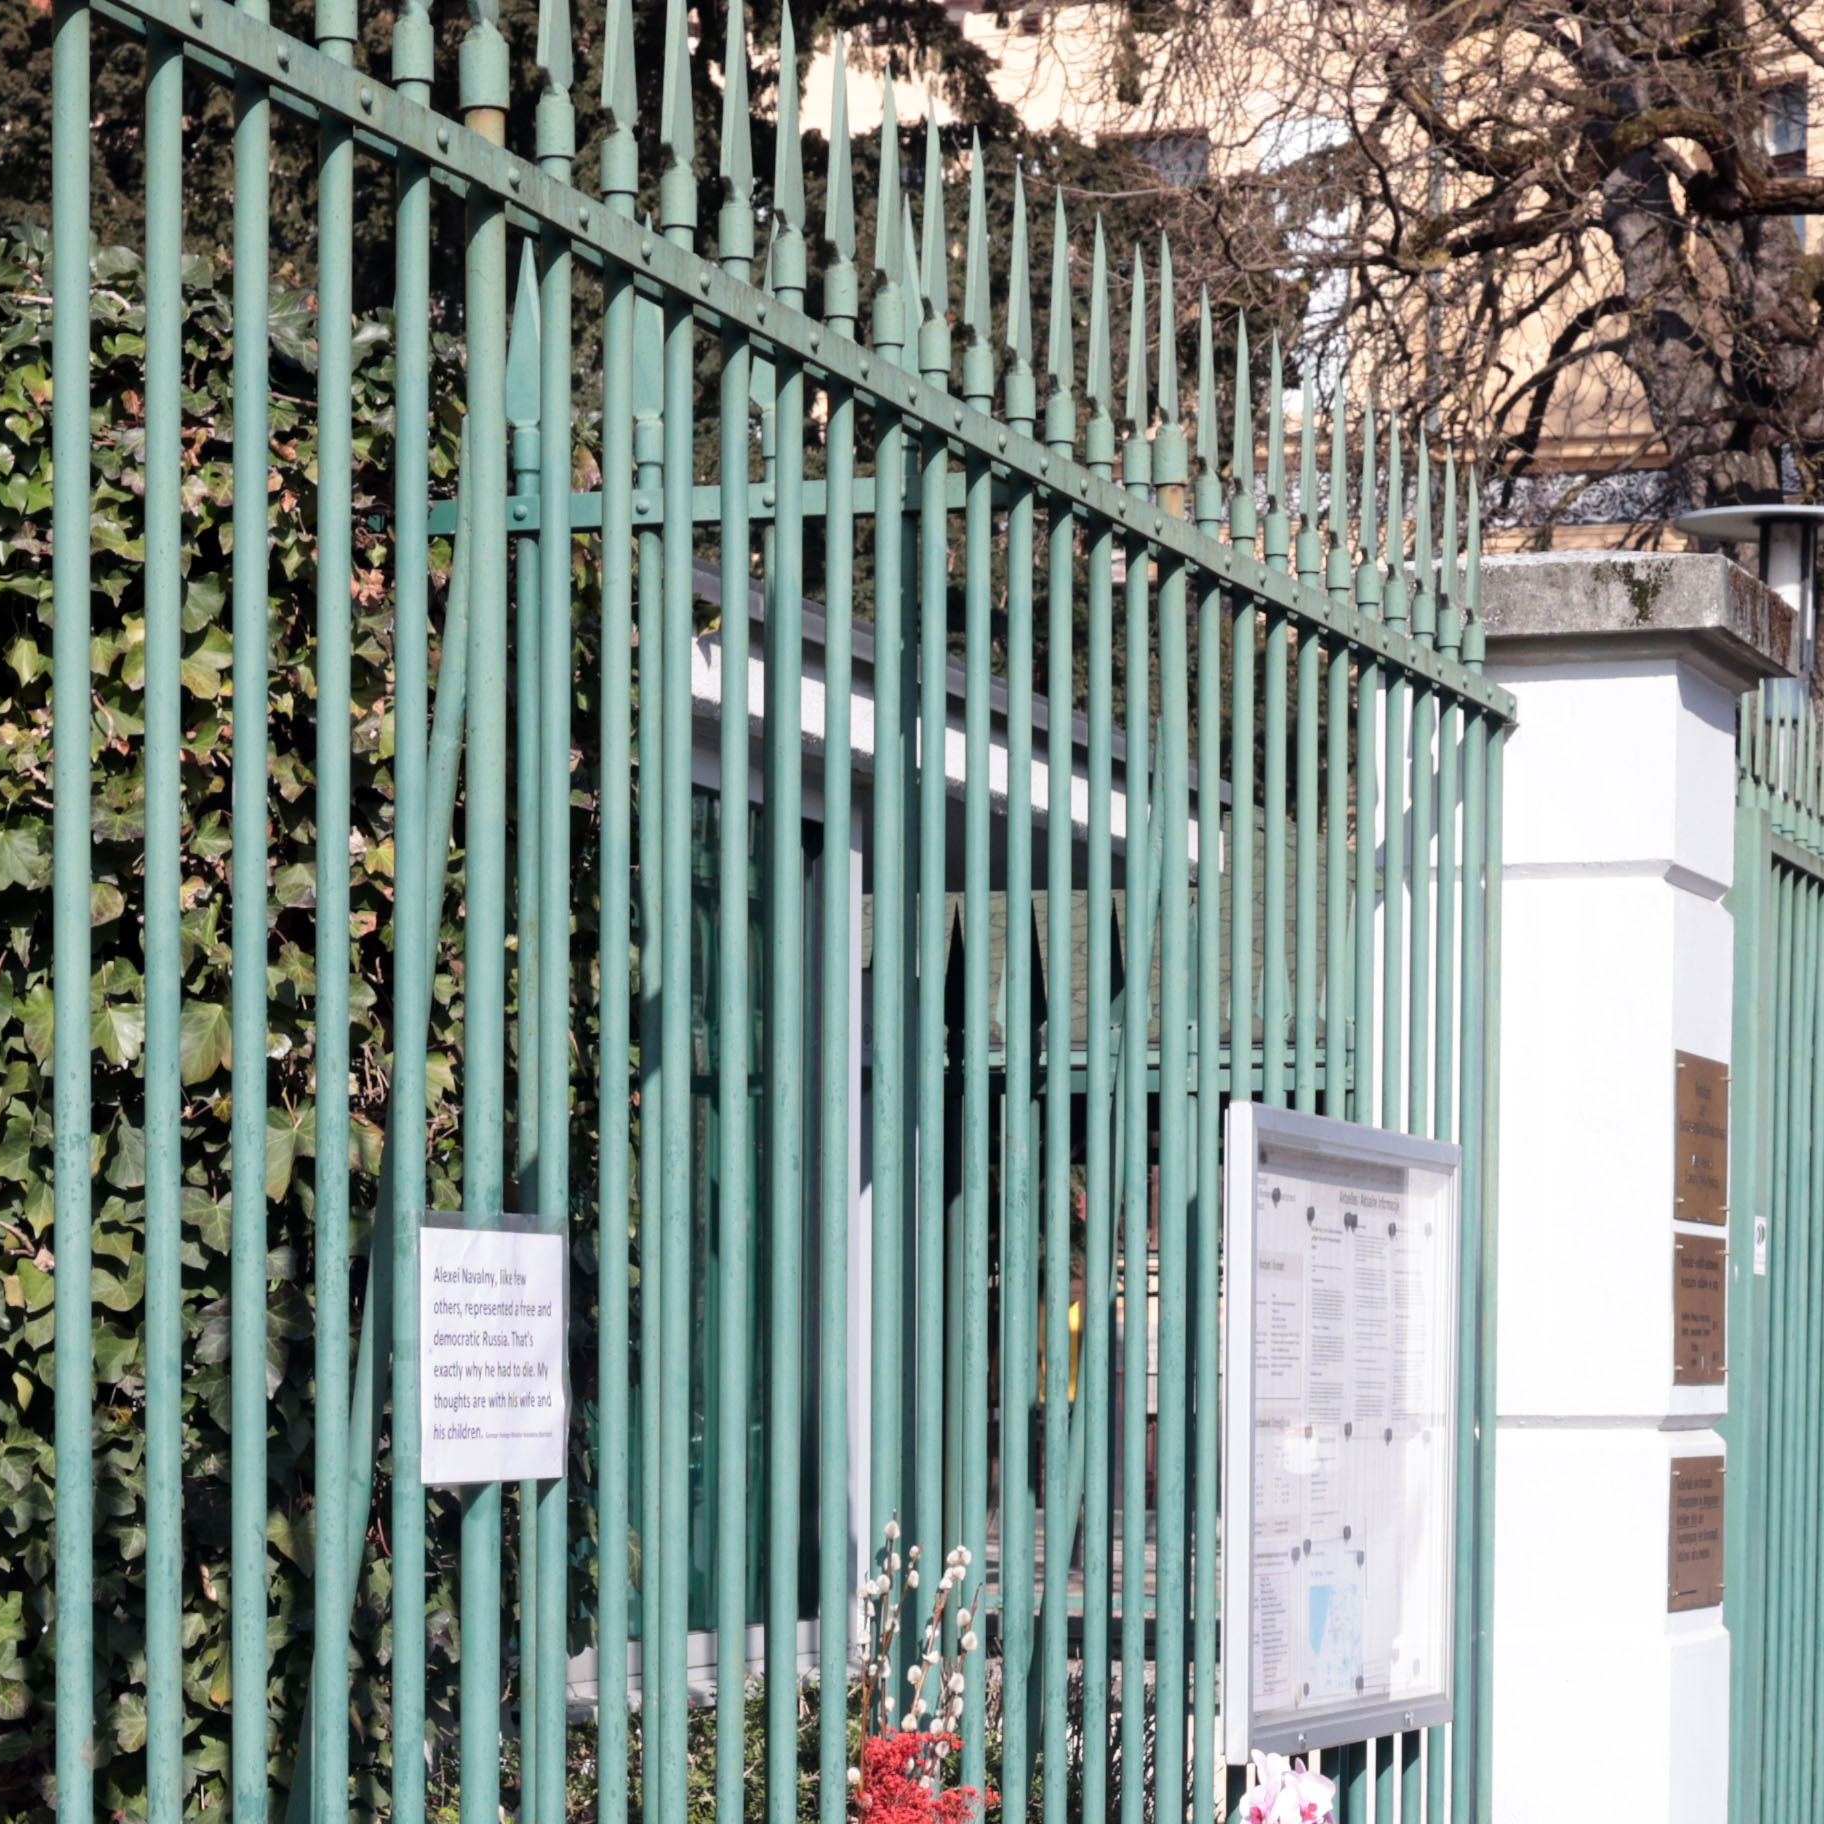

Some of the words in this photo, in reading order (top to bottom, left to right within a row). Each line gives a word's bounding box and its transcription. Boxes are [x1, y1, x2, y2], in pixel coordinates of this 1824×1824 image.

[434, 1266, 460, 1283] Alexei
[462, 1268, 497, 1288] Navalny,
[500, 1269, 512, 1285] like
[514, 1270, 526, 1286] few
[434, 1298, 462, 1317] others,
[465, 1300, 513, 1318] represented
[515, 1306, 519, 1316] a
[520, 1300, 535, 1316] free
[538, 1301, 551, 1317] and
[434, 1330, 480, 1346] democratic
[482, 1331, 509, 1346] Russia.
[434, 1361, 462, 1381] exactly
[466, 1361, 482, 1381] why
[485, 1361, 495, 1377] he
[498, 1361, 511, 1377] had
[514, 1363, 520, 1377] to
[522, 1362, 535, 1377] die.
[537, 1362, 548, 1381] My
[434, 1392, 470, 1412] thoughts
[473, 1397, 486, 1408] are
[489, 1393, 506, 1408] with
[508, 1393, 517, 1408] his
[520, 1392, 535, 1407] wife
[538, 1392, 552, 1407] and
[434, 1423, 445, 1440] his
[448, 1423, 483, 1440] children.
